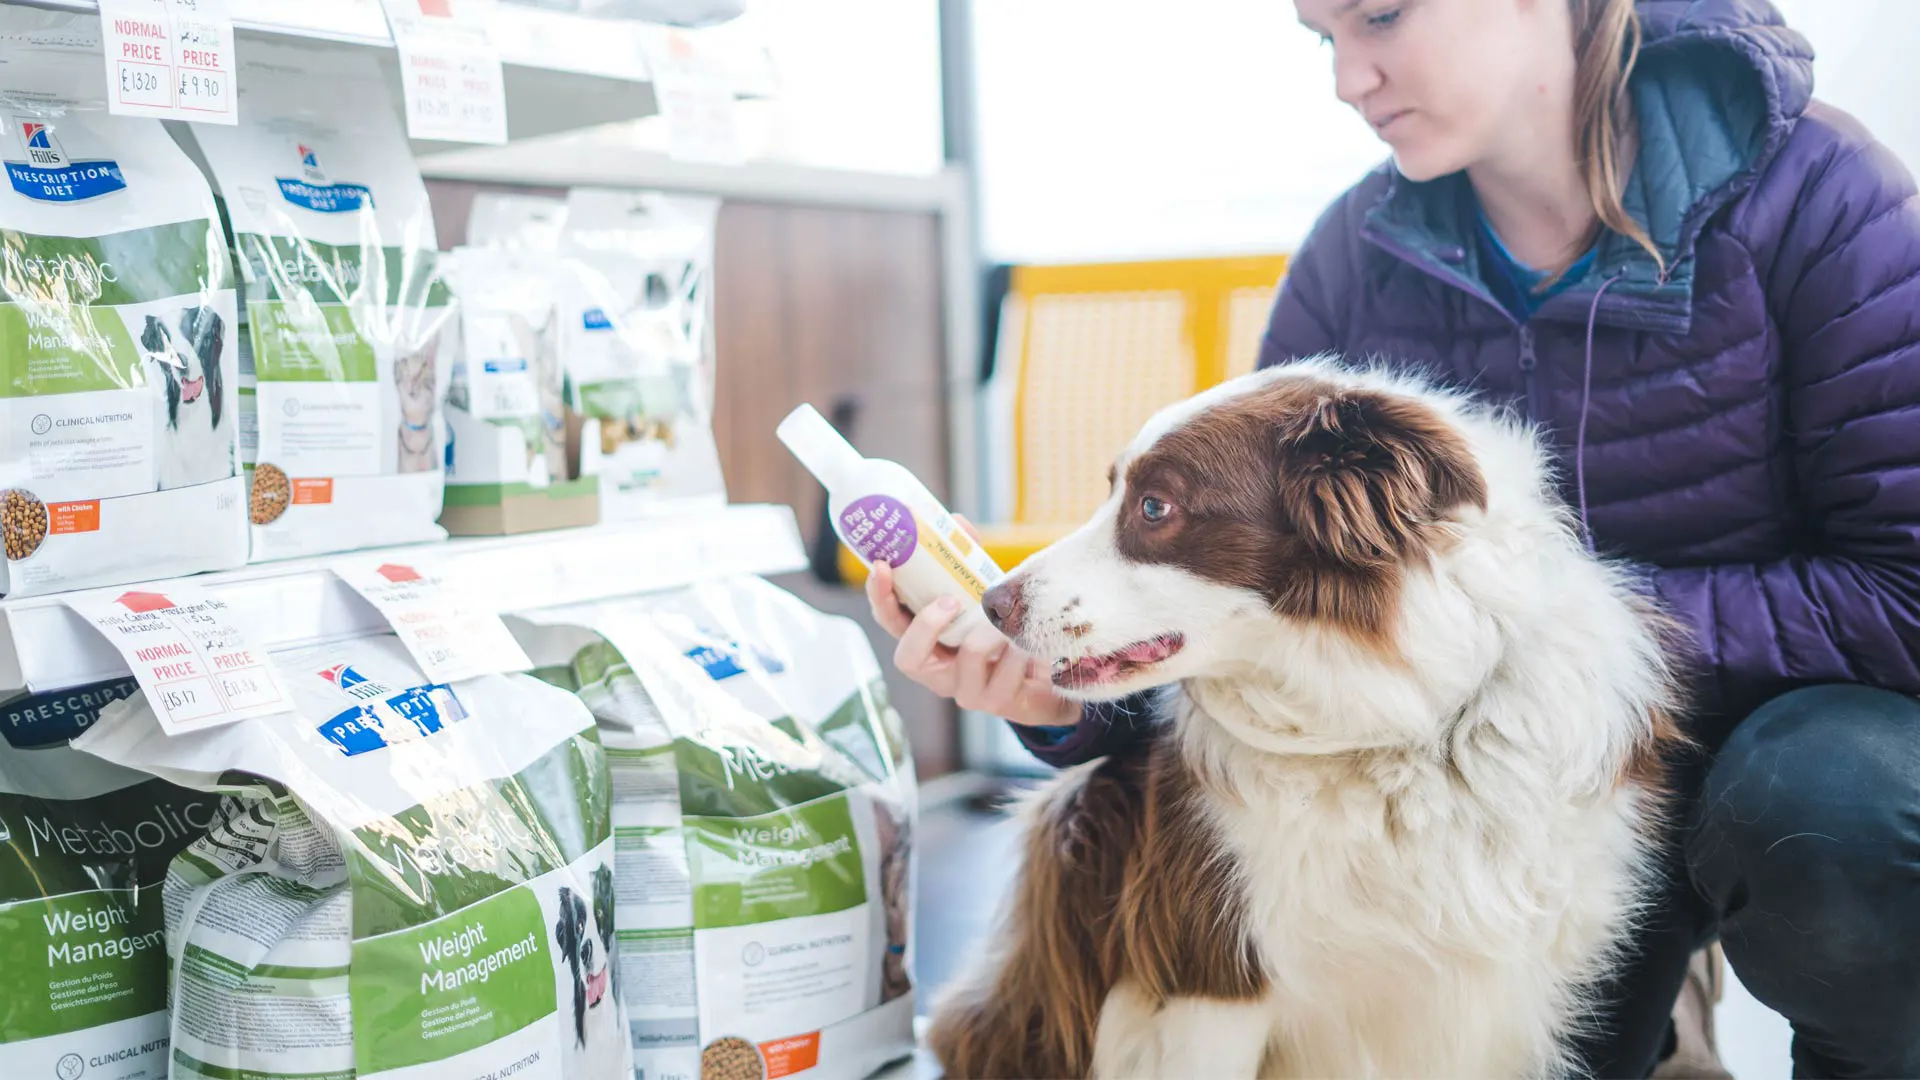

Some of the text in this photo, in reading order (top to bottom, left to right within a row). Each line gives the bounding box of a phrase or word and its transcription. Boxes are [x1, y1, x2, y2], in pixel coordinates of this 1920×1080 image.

[115, 20, 166, 39] NORMAL
[123, 43, 162, 60] PRICE
[183, 50, 220, 67] PRICE
[30, 149, 61, 164] Hill's
[12, 166, 111, 184] PRESCRIPTION
[44, 183, 73, 196] DIET
[56, 413, 133, 428] CLINICAL NUTRITION
[57, 504, 93, 513] with Chicken
[845, 505, 867, 526] Pay
[848, 501, 889, 545] LESS for
[873, 528, 888, 543] on
[884, 507, 902, 530] our
[136, 642, 192, 663] NORMAL
[213, 651, 254, 669] PRICE
[153, 661, 197, 680] PRICE
[24, 801, 210, 858] Metabolic
[43, 904, 130, 936] Weight
[419, 921, 488, 965] Weight
[420, 932, 539, 996] Management
[49, 970, 114, 990] Gestion du Poids
[49, 980, 119, 1001] Gestione del Peso
[50, 988, 135, 1011] Gewichtsmanagement
[421, 1005, 450, 1018] Gestion
[450, 1002, 460, 1011] du
[421, 1005, 481, 1029] Gestione del Peso
[421, 1010, 494, 1040] Gewichtsmanagement
[89, 1046, 140, 1069] CLINICAL
[499, 1049, 541, 1079] NUTRITION
